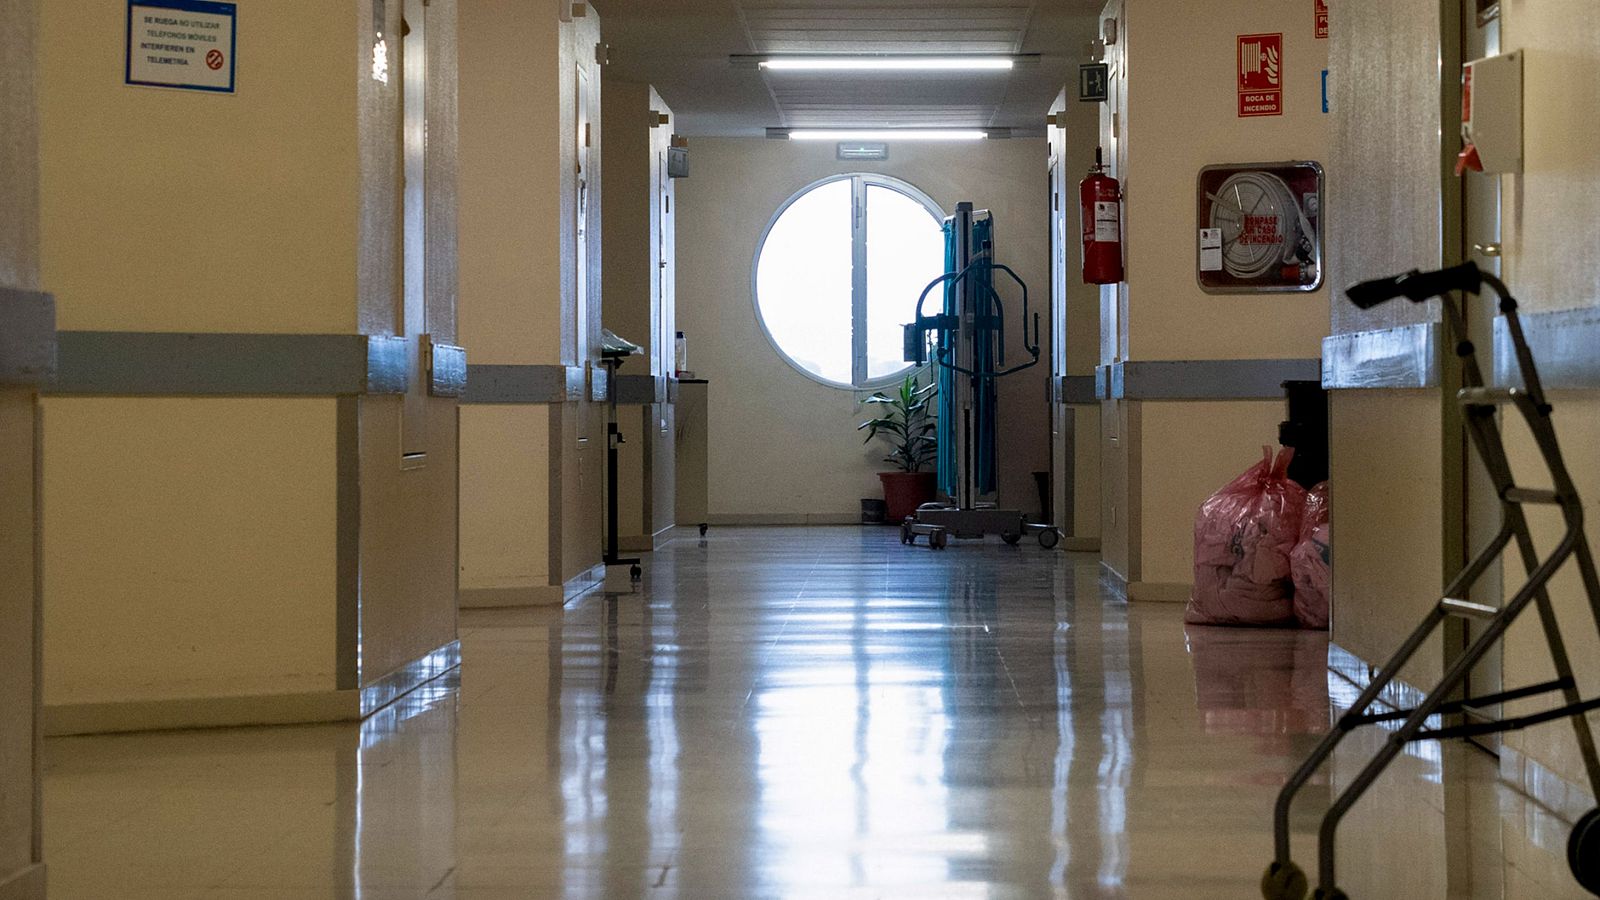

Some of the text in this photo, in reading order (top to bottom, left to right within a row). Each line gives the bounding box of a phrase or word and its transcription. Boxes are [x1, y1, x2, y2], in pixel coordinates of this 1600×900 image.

[144, 16, 220, 29] SE RUEGA NO UTILIZAR
[141, 42, 184, 53] INTERFIEREN
[1243, 104, 1277, 112] INCENDIO
